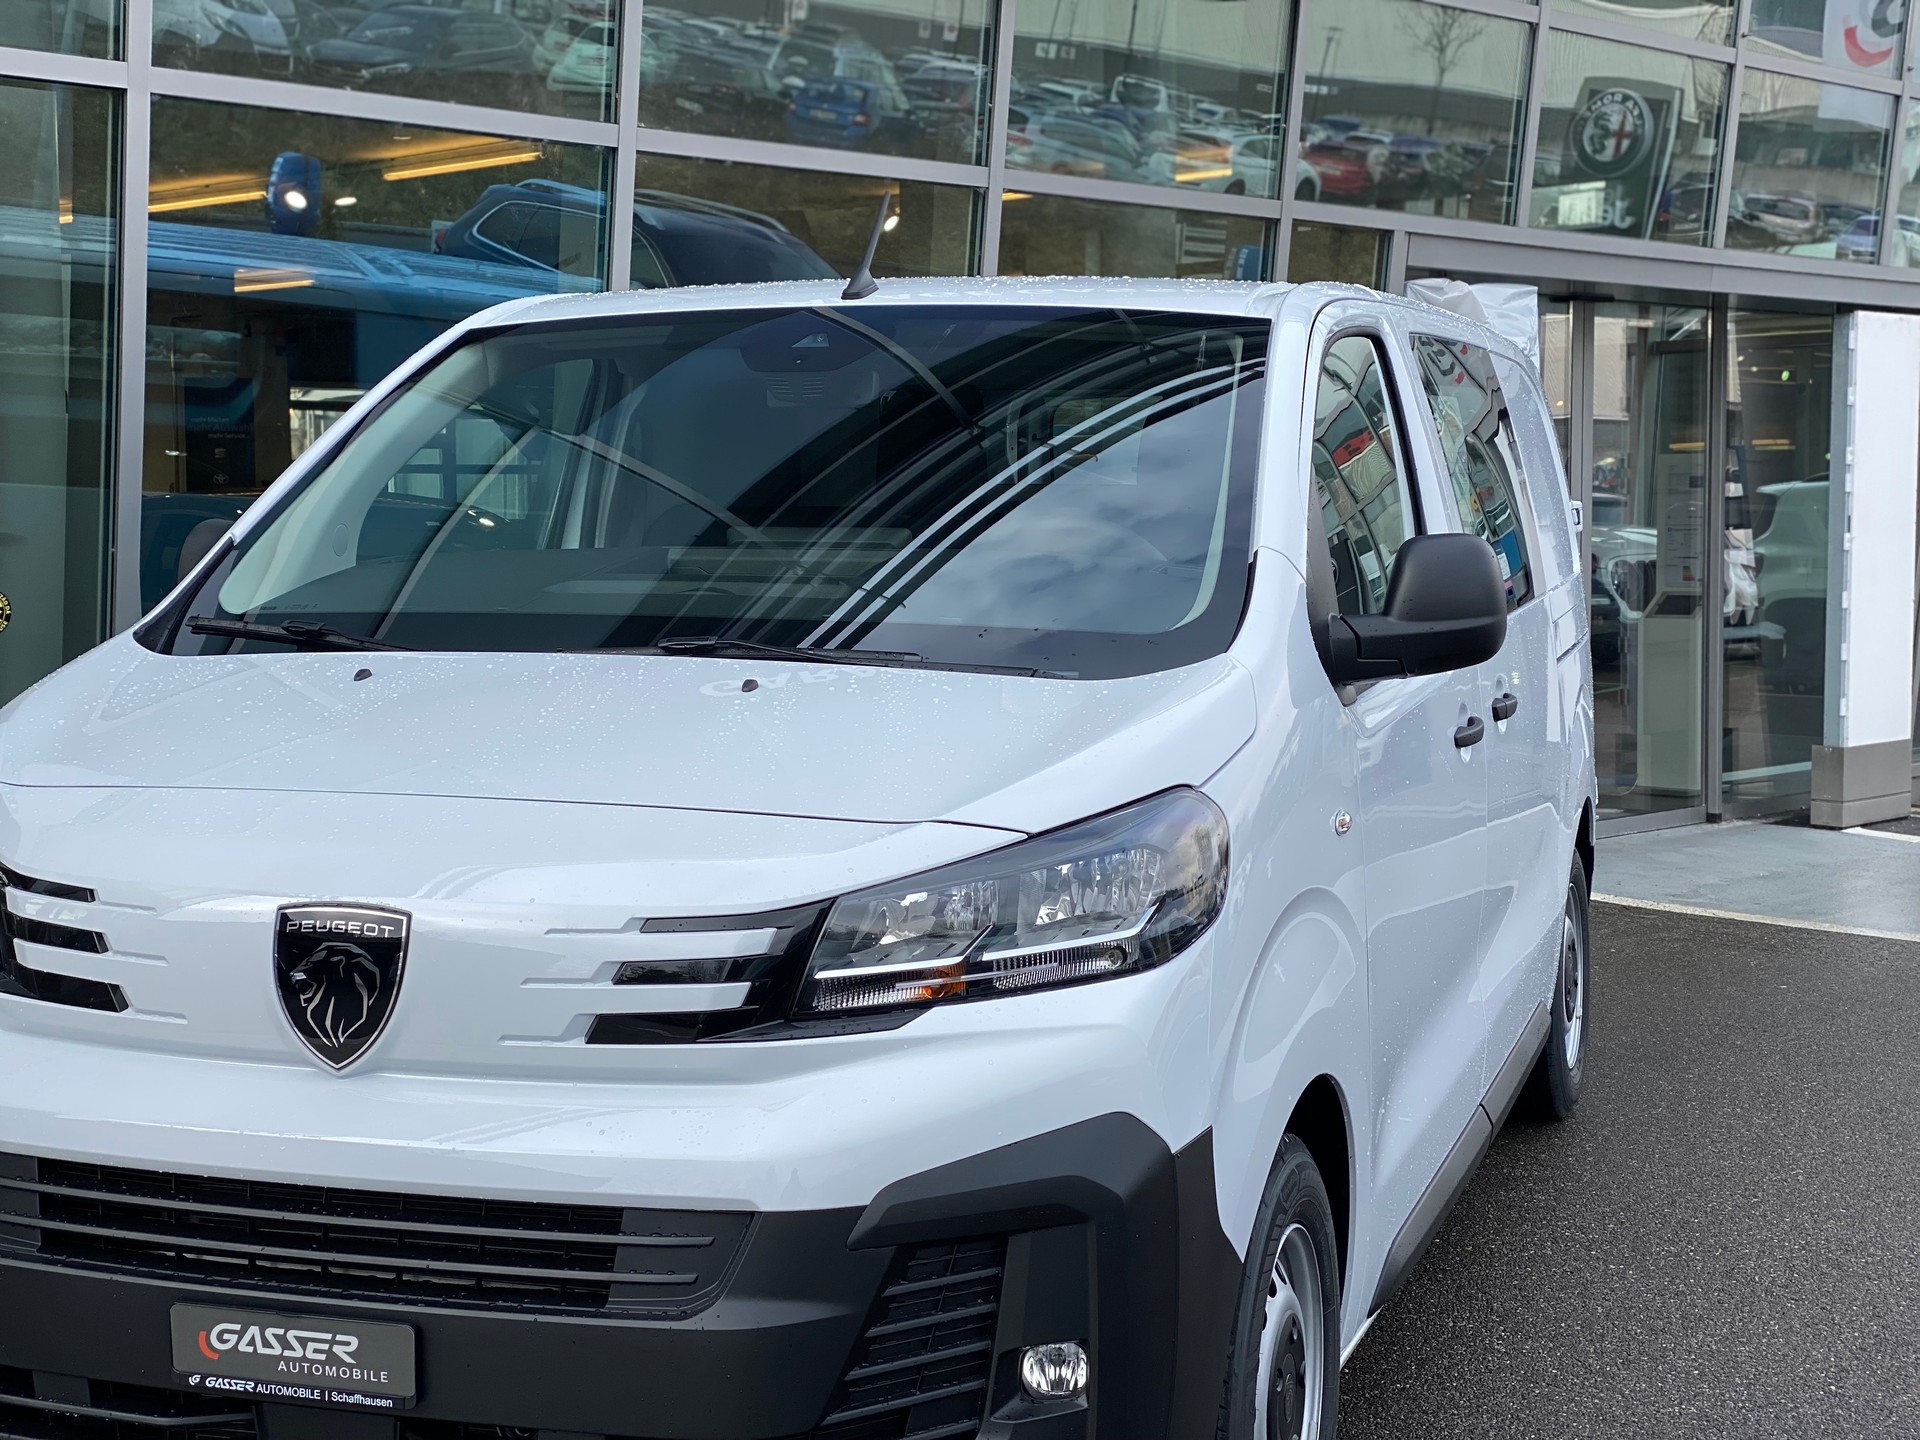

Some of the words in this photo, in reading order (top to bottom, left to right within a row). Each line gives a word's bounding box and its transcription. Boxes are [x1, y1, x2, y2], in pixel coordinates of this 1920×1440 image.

[286, 920, 394, 938] PEUGEOT
[209, 1322, 359, 1364] GASSER
[277, 1360, 389, 1383] AUTOMOBILE
[205, 1376, 255, 1392] GASSER
[256, 1383, 321, 1400] AUTOMOBILE
[331, 1391, 393, 1408] Schaffhausen
